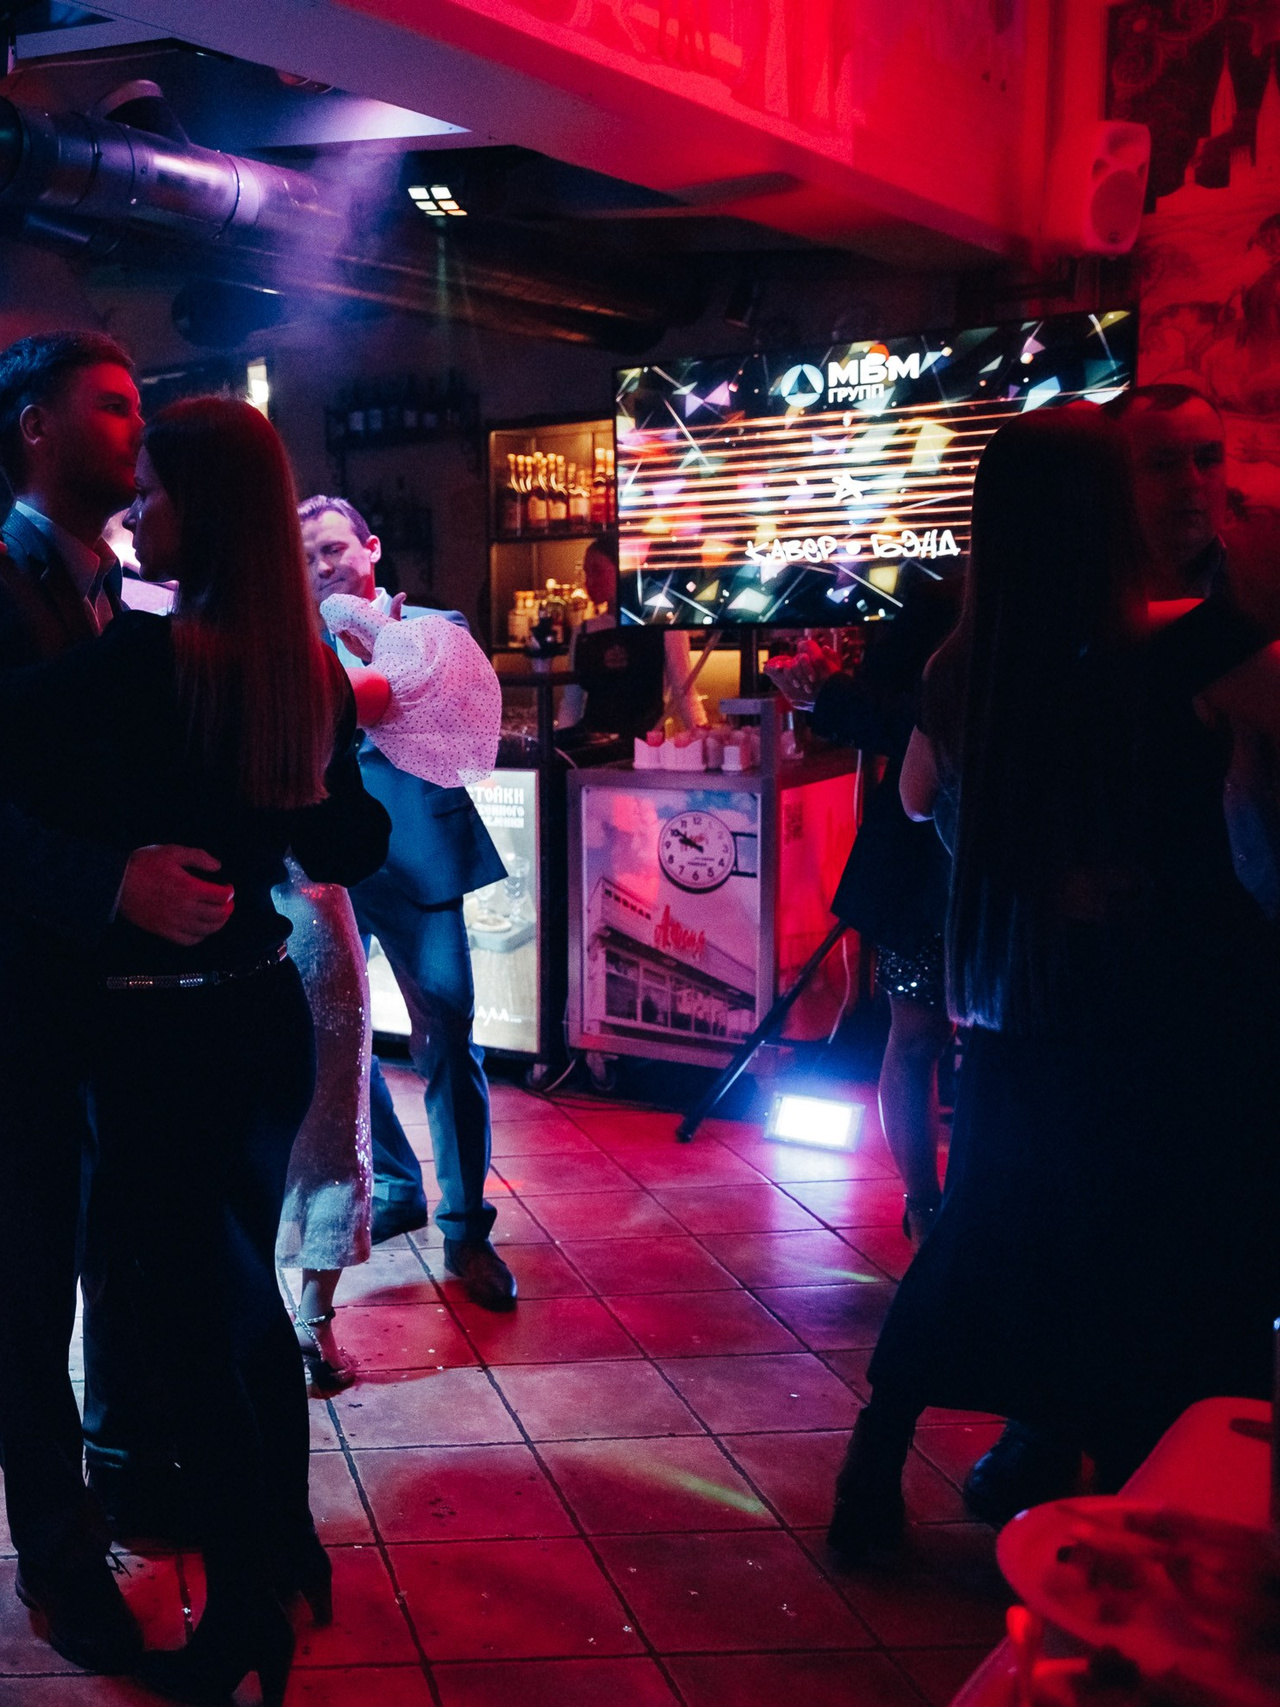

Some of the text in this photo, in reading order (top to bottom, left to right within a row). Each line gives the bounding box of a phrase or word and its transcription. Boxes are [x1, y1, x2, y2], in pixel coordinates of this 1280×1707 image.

[828, 352, 920, 388] МБМ
[828, 383, 885, 403] ГРУПП
[871, 529, 962, 560] БЭНД
